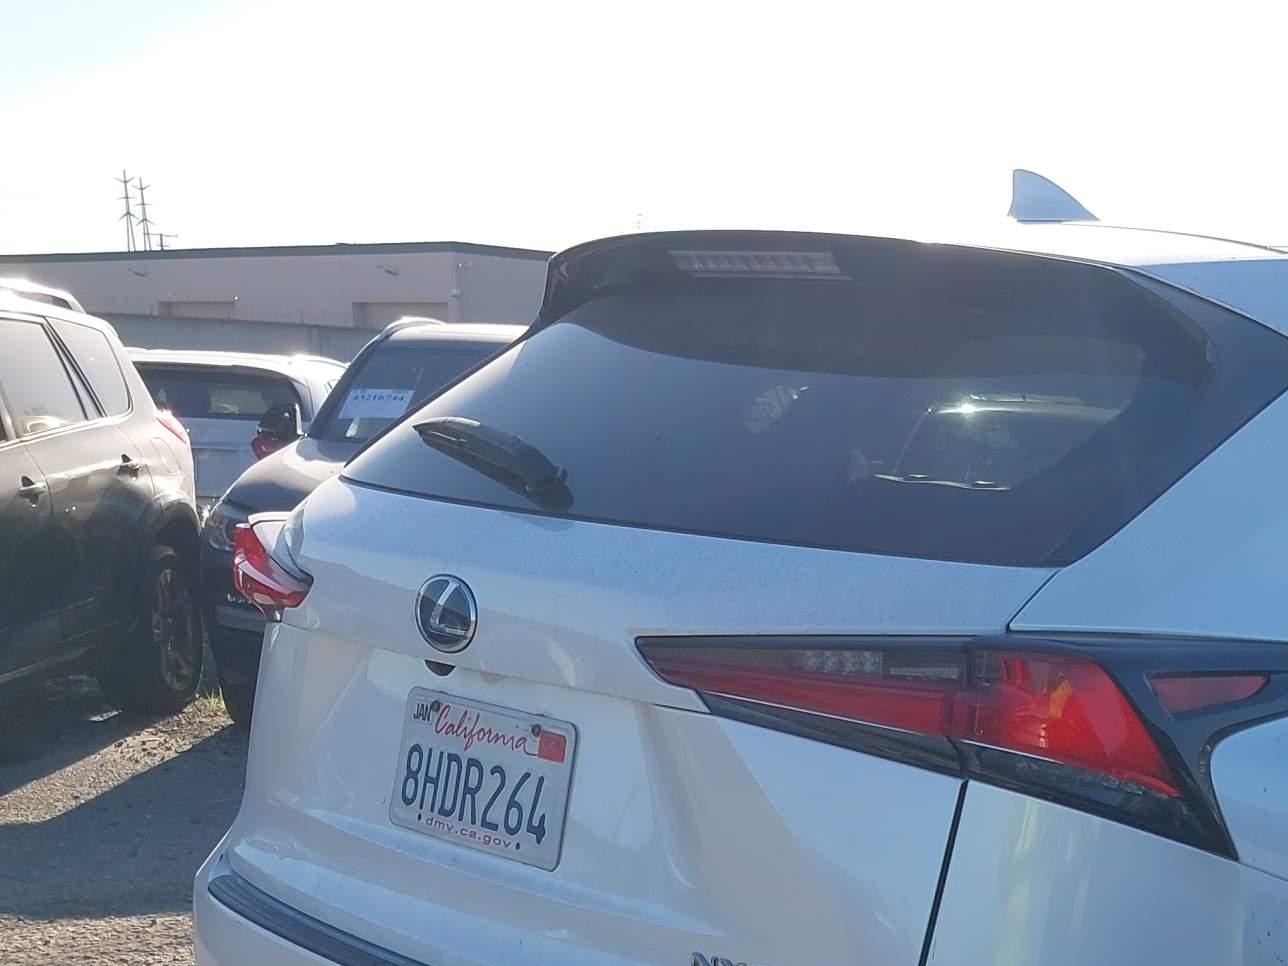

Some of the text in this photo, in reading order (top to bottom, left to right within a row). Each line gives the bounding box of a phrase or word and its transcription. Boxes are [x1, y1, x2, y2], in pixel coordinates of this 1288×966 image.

[413, 703, 433, 722] JAN
[434, 703, 538, 757] California
[401, 744, 546, 845] 8HDR264
[425, 815, 512, 848] dmv.ca.gov
